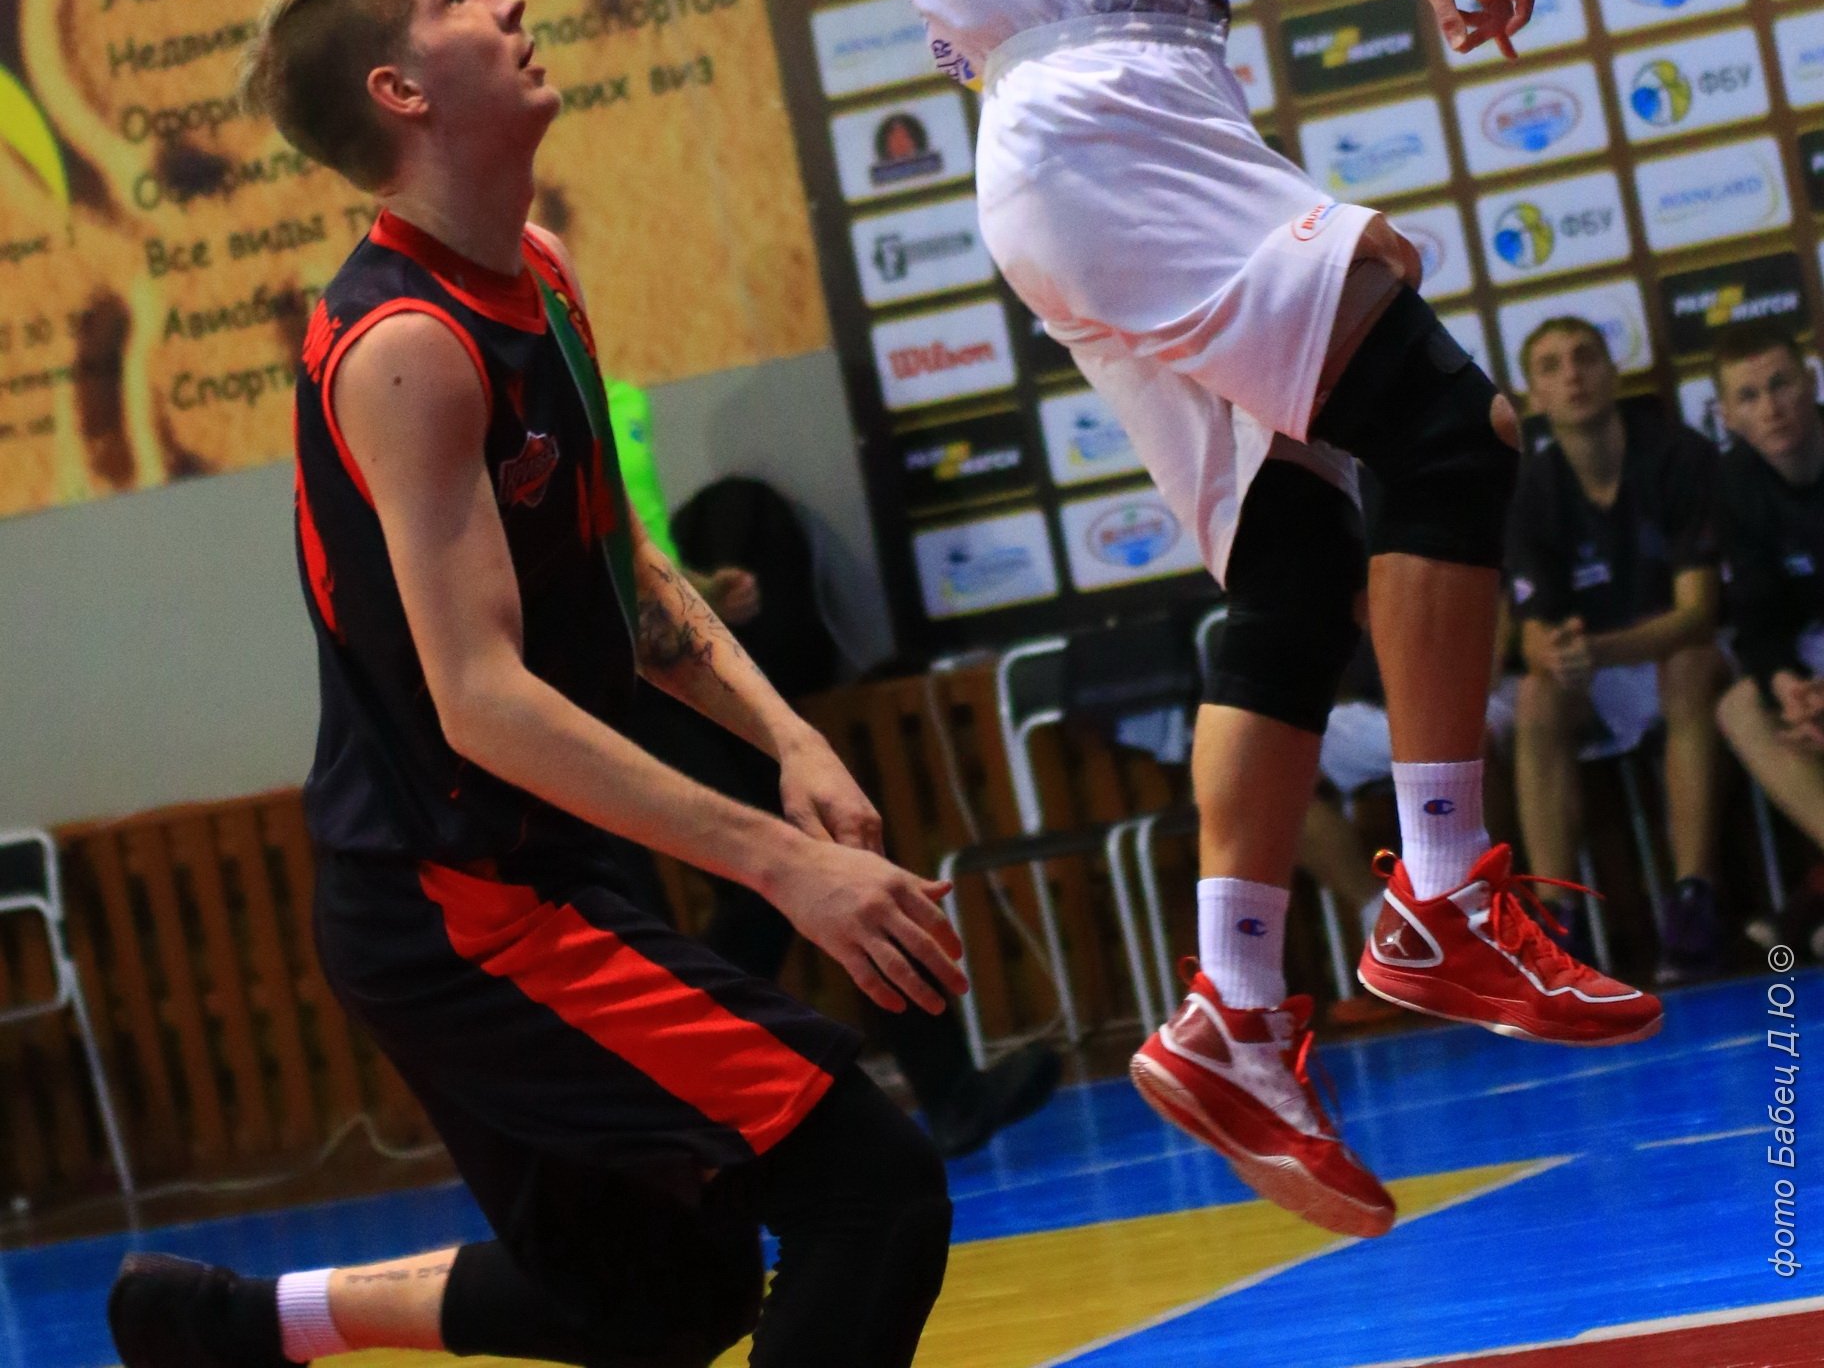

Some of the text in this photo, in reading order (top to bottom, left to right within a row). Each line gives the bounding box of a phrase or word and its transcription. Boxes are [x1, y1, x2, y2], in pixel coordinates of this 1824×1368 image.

[144, 236, 210, 278] Все
[228, 213, 327, 261] виды
[888, 337, 995, 382] Wilson
